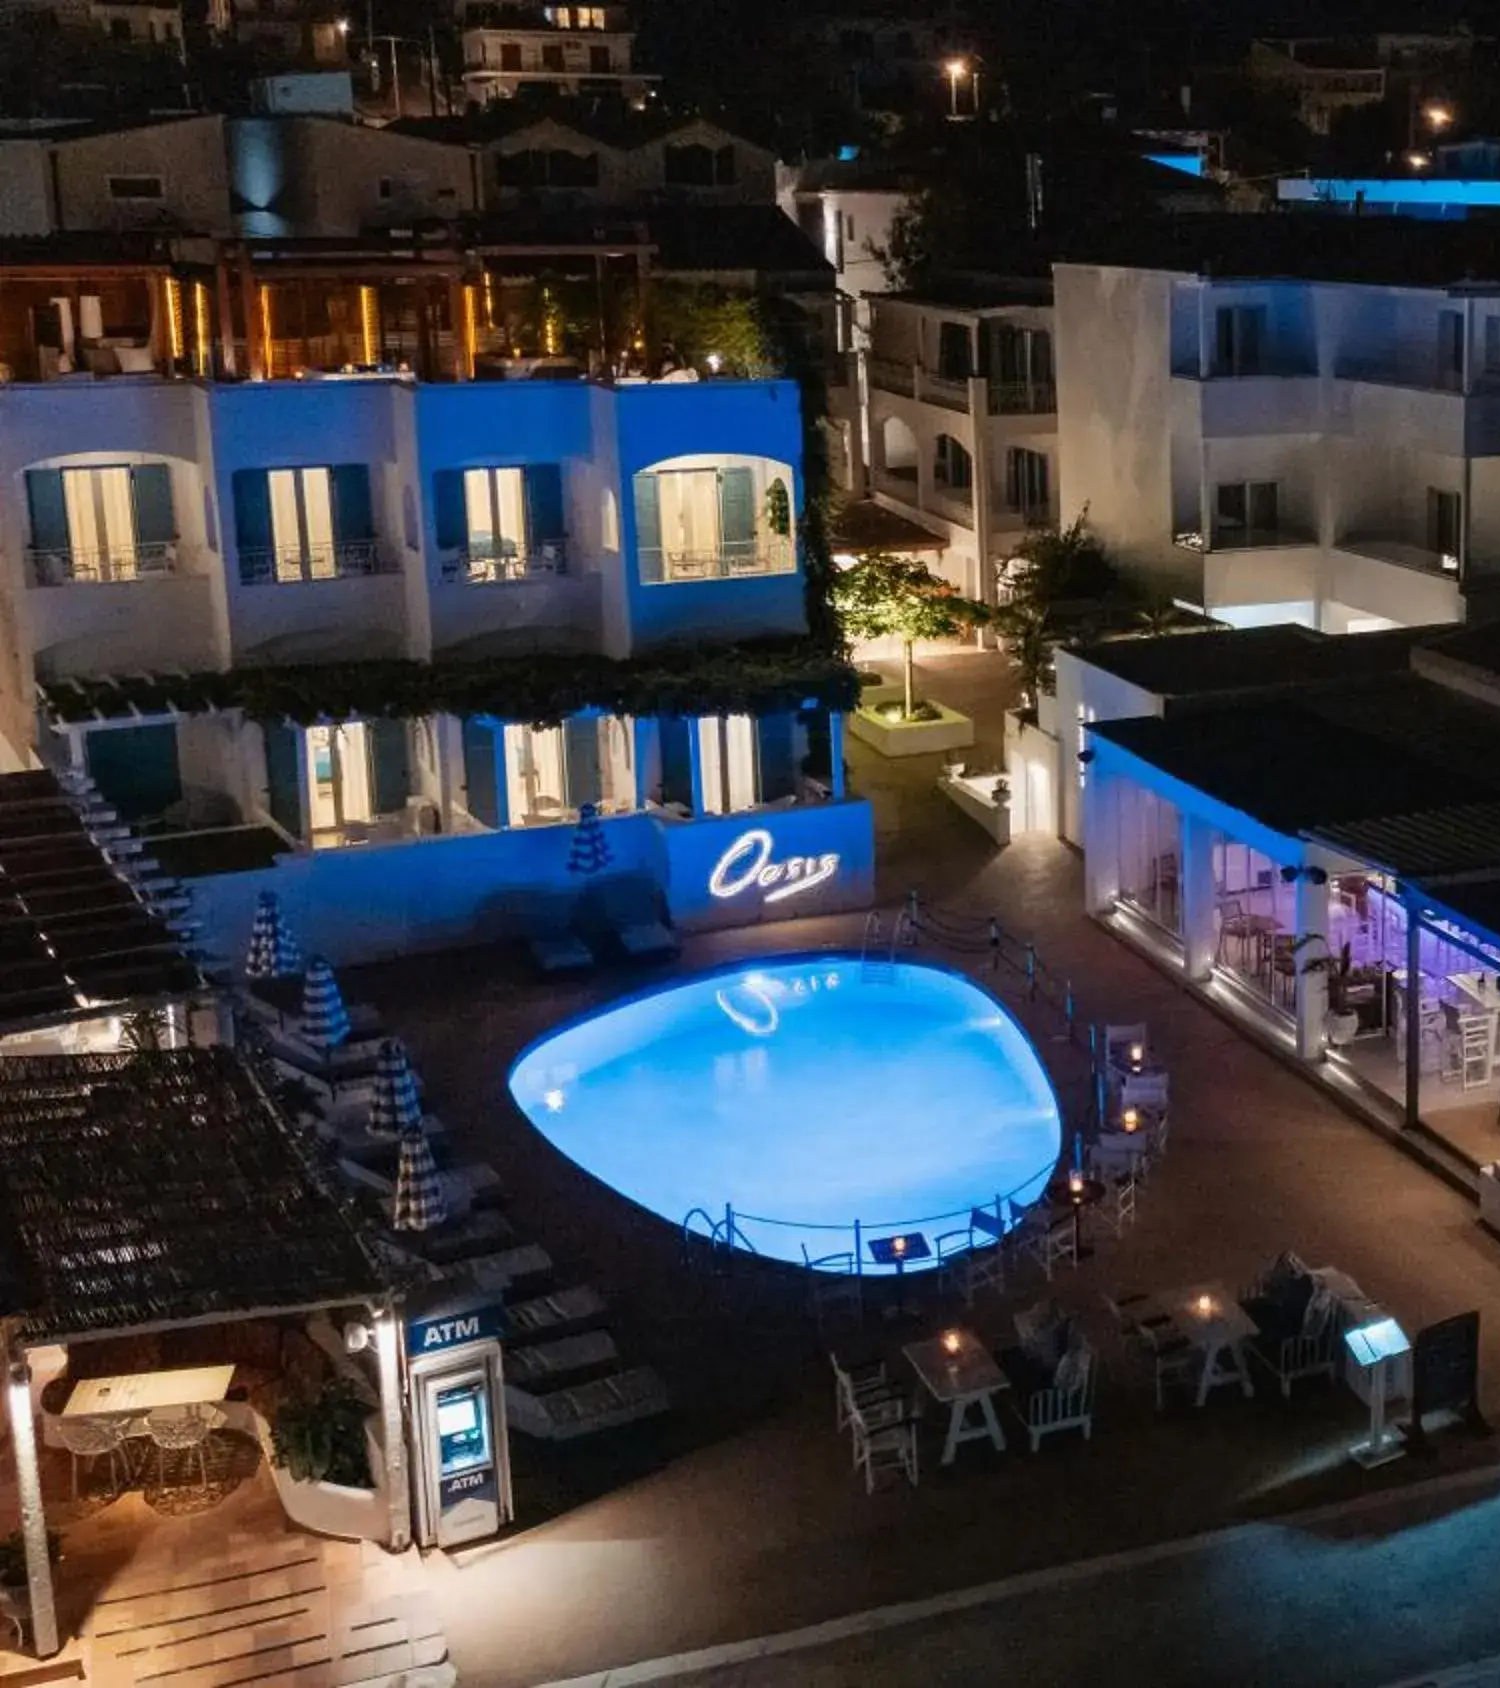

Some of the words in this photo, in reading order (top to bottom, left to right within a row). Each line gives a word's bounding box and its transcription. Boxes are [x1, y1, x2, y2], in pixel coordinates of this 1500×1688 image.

[710, 830, 840, 902] Oasis
[424, 1317, 479, 1348] ATM
[450, 1473, 484, 1491] ATM
